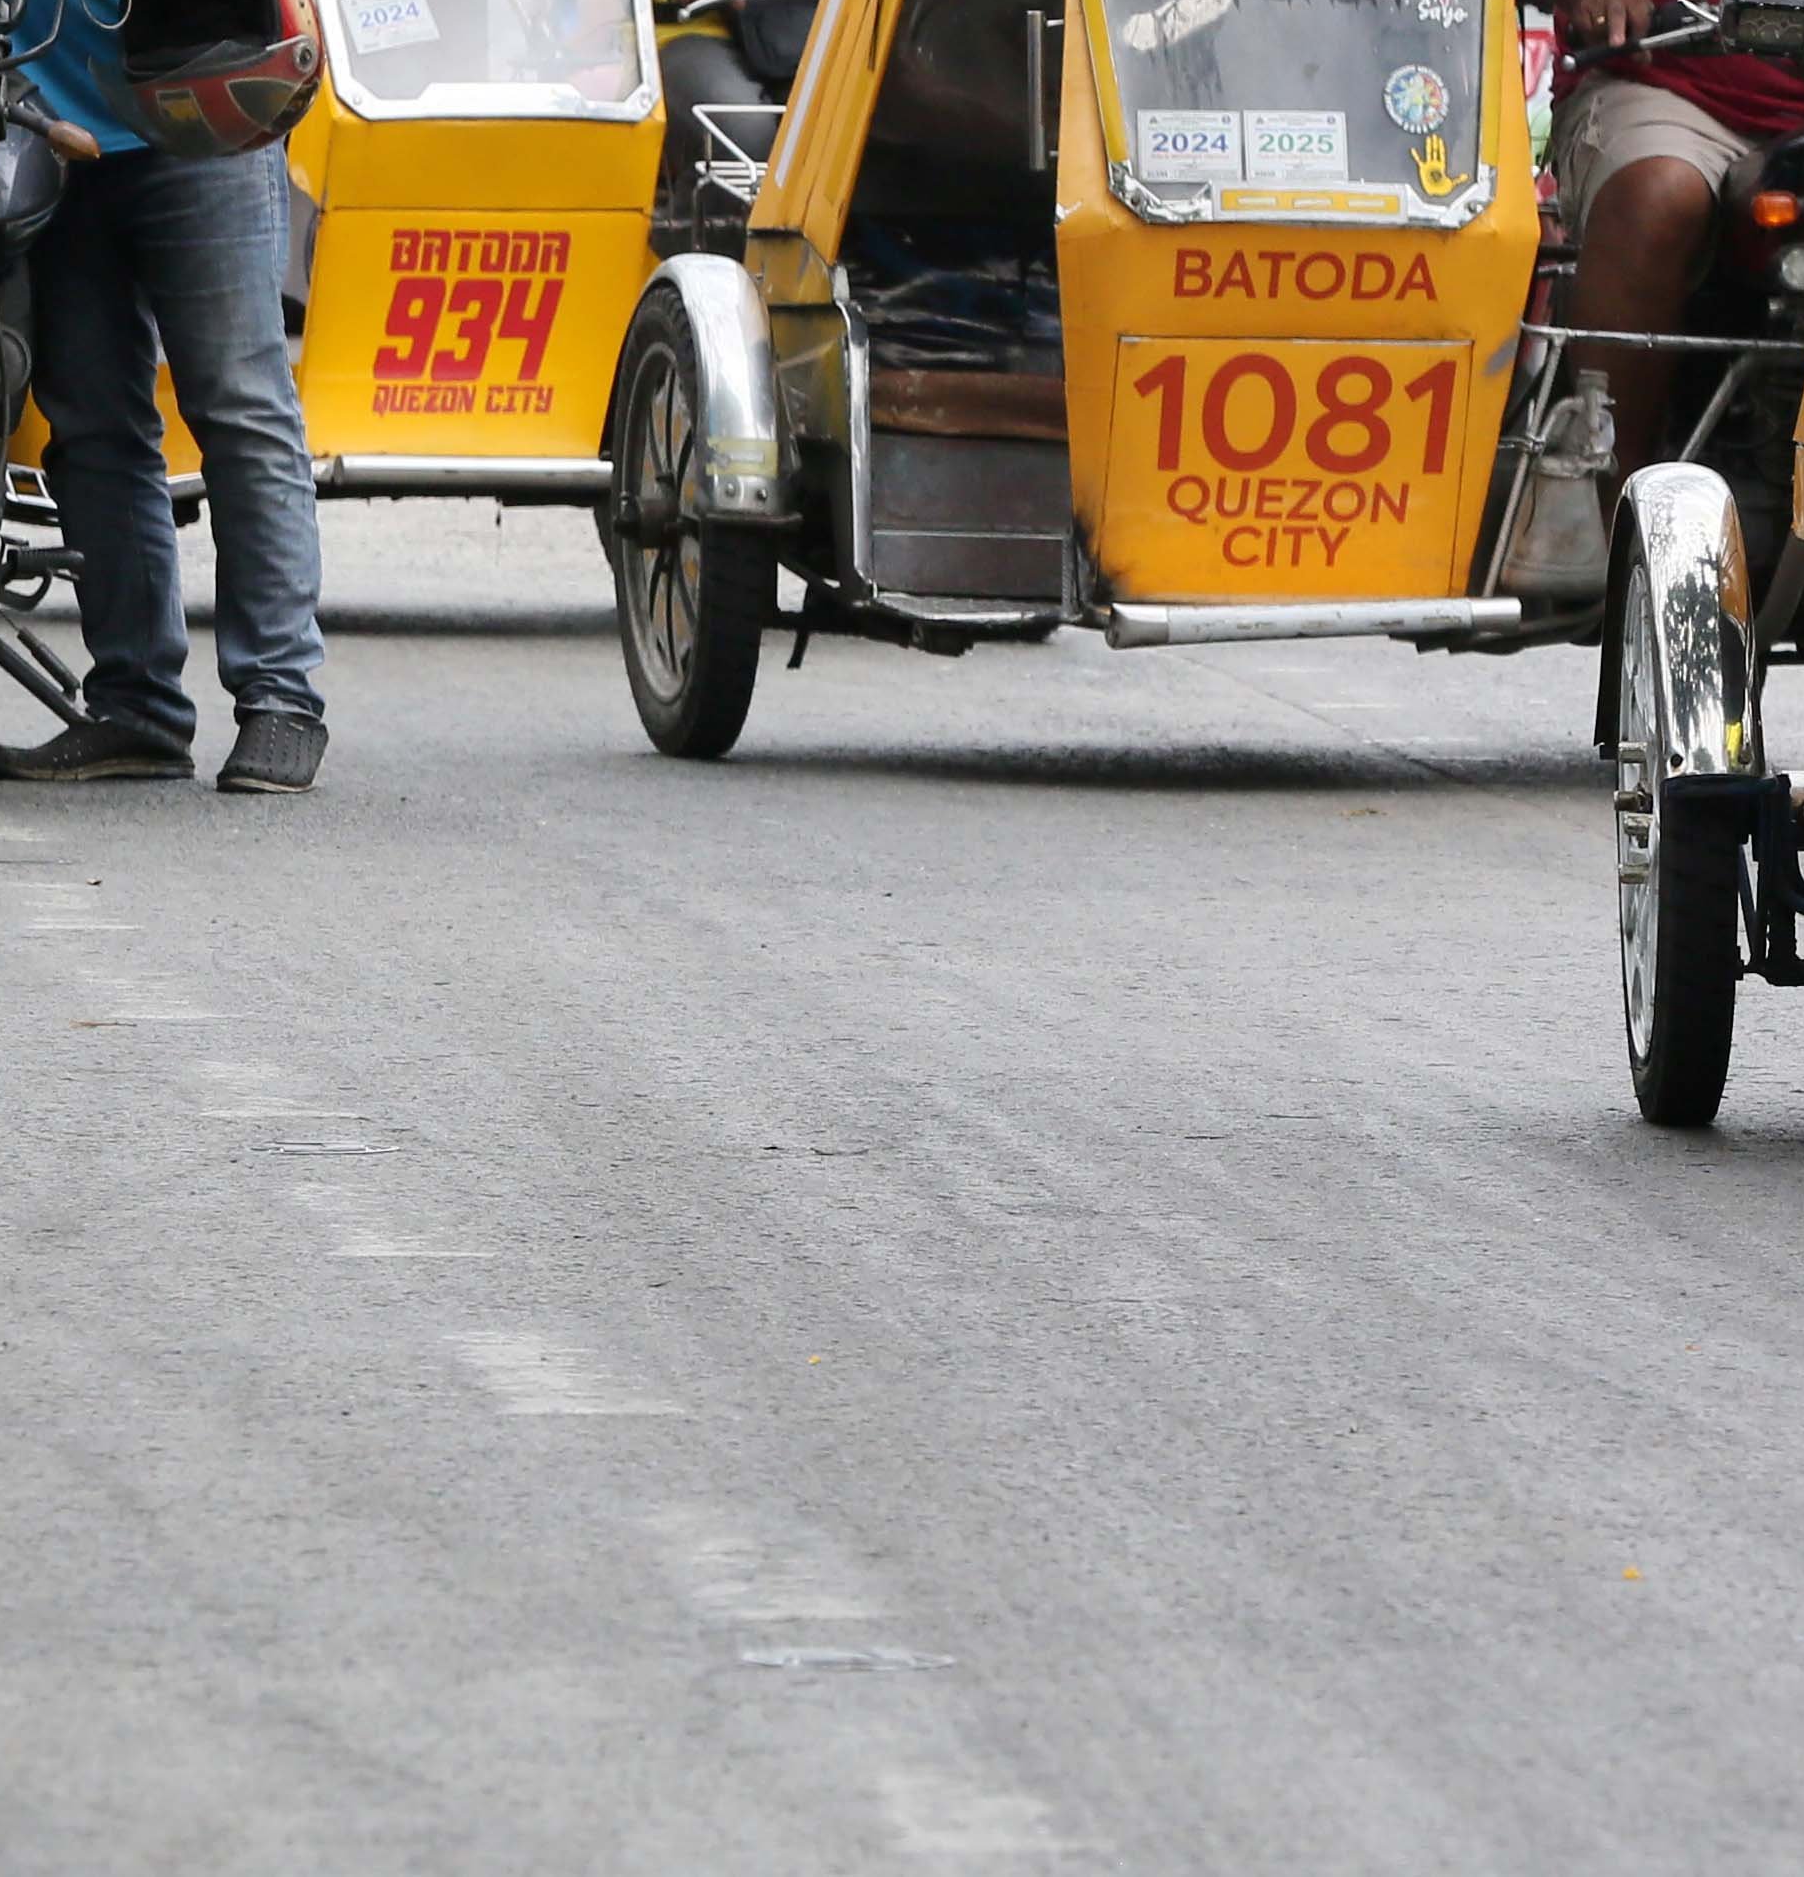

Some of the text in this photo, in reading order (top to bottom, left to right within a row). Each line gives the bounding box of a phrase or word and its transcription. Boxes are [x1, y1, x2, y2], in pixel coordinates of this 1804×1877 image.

[358, 2, 420, 28] 2024
[1417, 0, 1469, 29] Sayo
[1152, 133, 1229, 153] 2024
[1258, 133, 1334, 153] 2025
[391, 230, 571, 273] BATODA
[1174, 249, 1438, 301] BATODA
[374, 278, 564, 380] 934
[372, 385, 553, 418] QUEZON CITY
[1134, 354, 1457, 475] 1081
[1167, 476, 1410, 524] QUEZON
[1223, 527, 1350, 567] CITY
